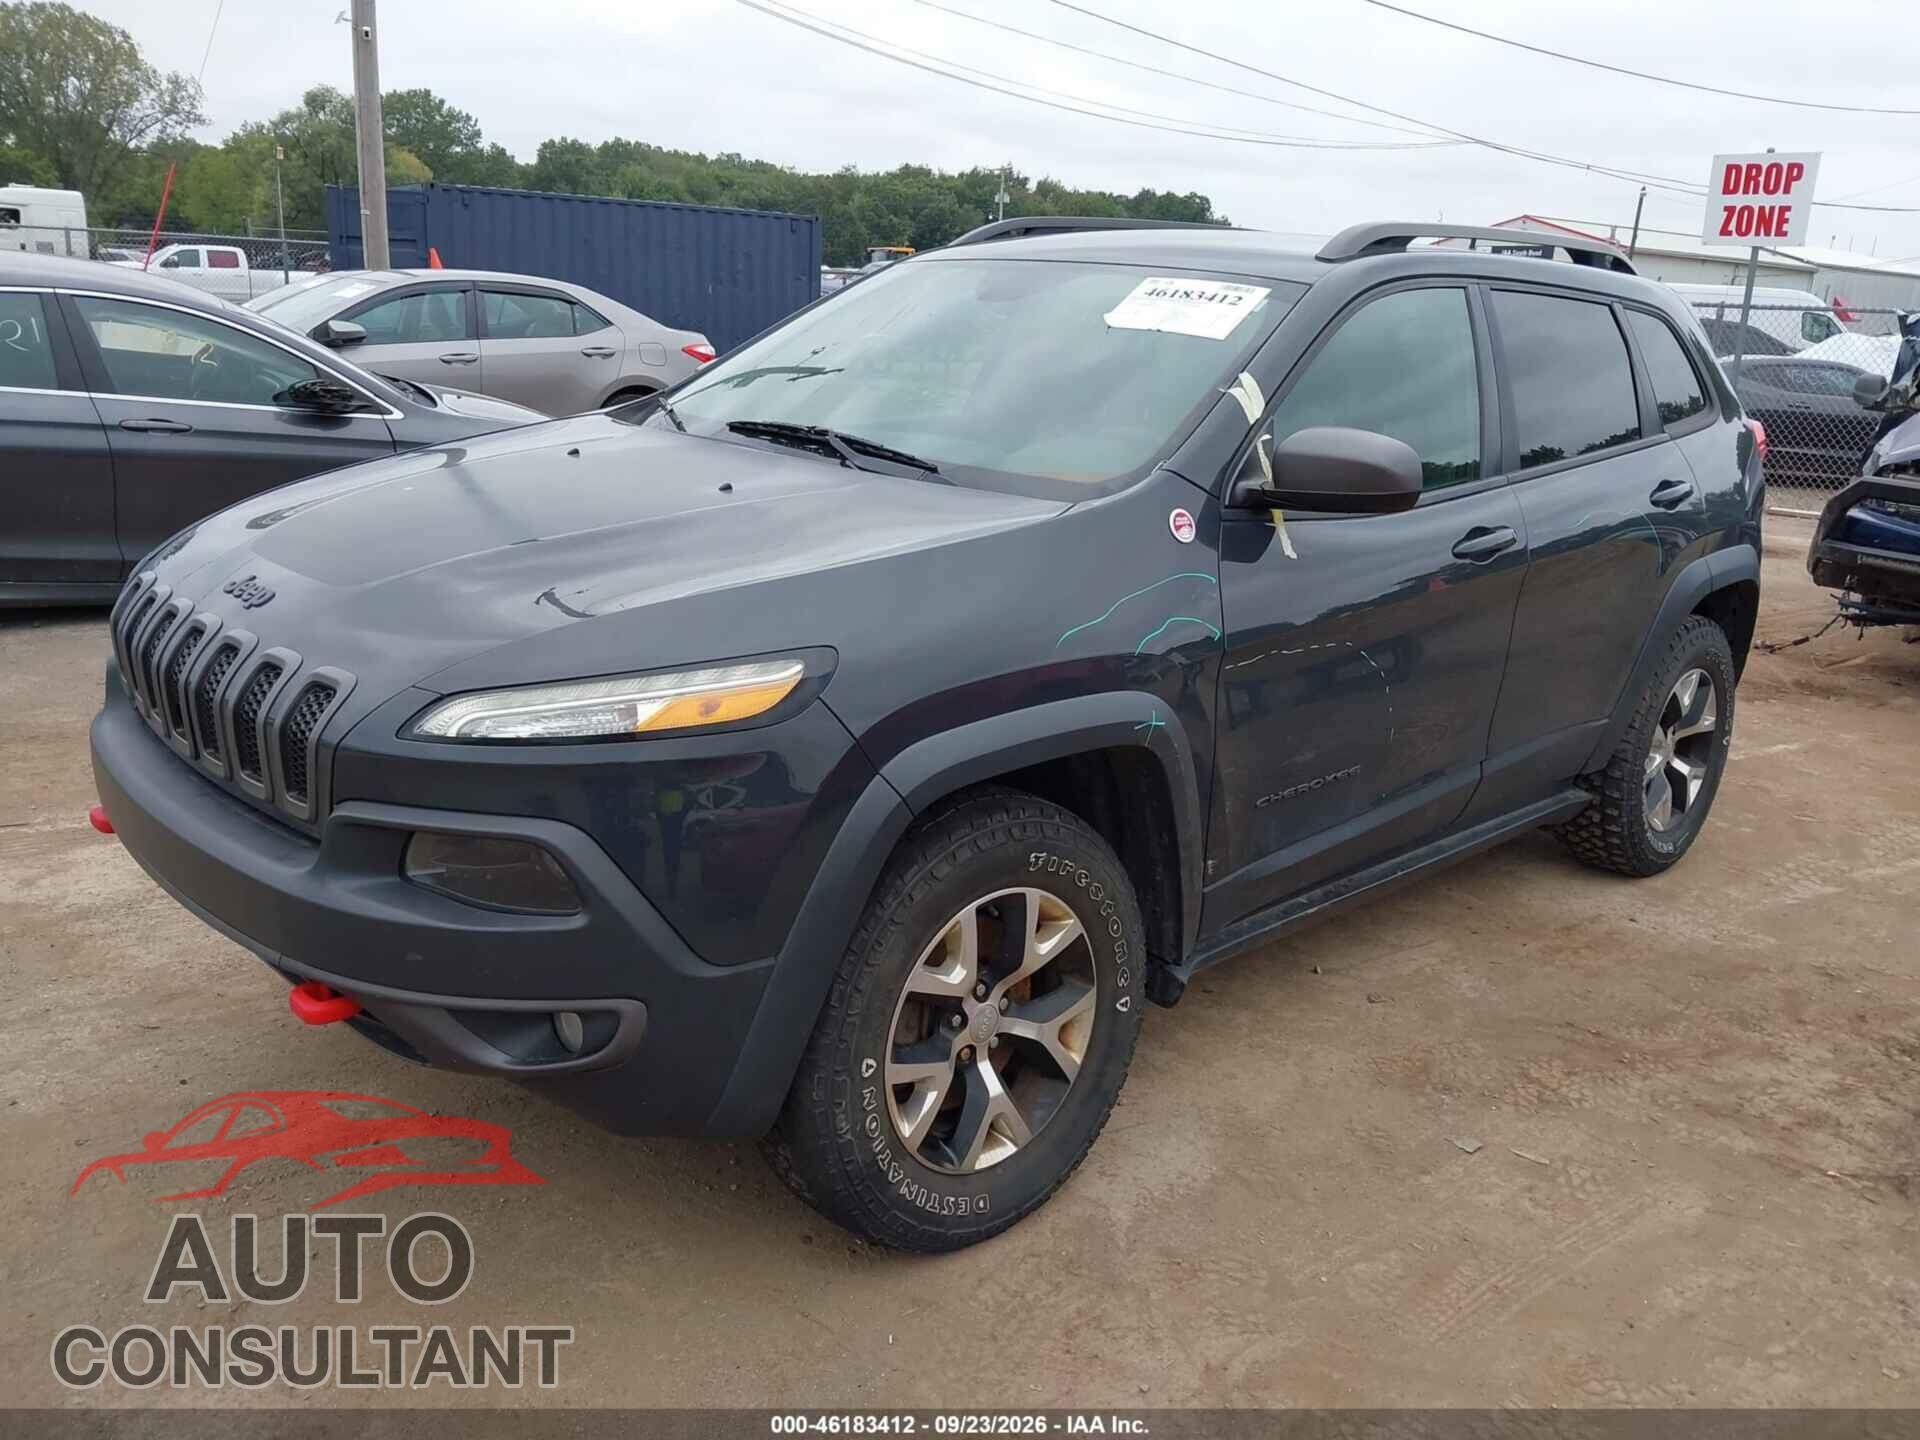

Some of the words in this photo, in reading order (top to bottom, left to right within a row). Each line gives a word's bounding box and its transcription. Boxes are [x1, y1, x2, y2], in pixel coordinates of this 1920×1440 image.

[1722, 162, 1804, 195] DROP
[1719, 205, 1792, 237] ZONE
[1144, 288, 1243, 306] 46183412
[223, 575, 276, 610] Jeep
[1255, 765, 1361, 808] CHEROKEE
[1029, 852, 1130, 987] Firestone
[862, 1086, 990, 1216] DESTINATION
